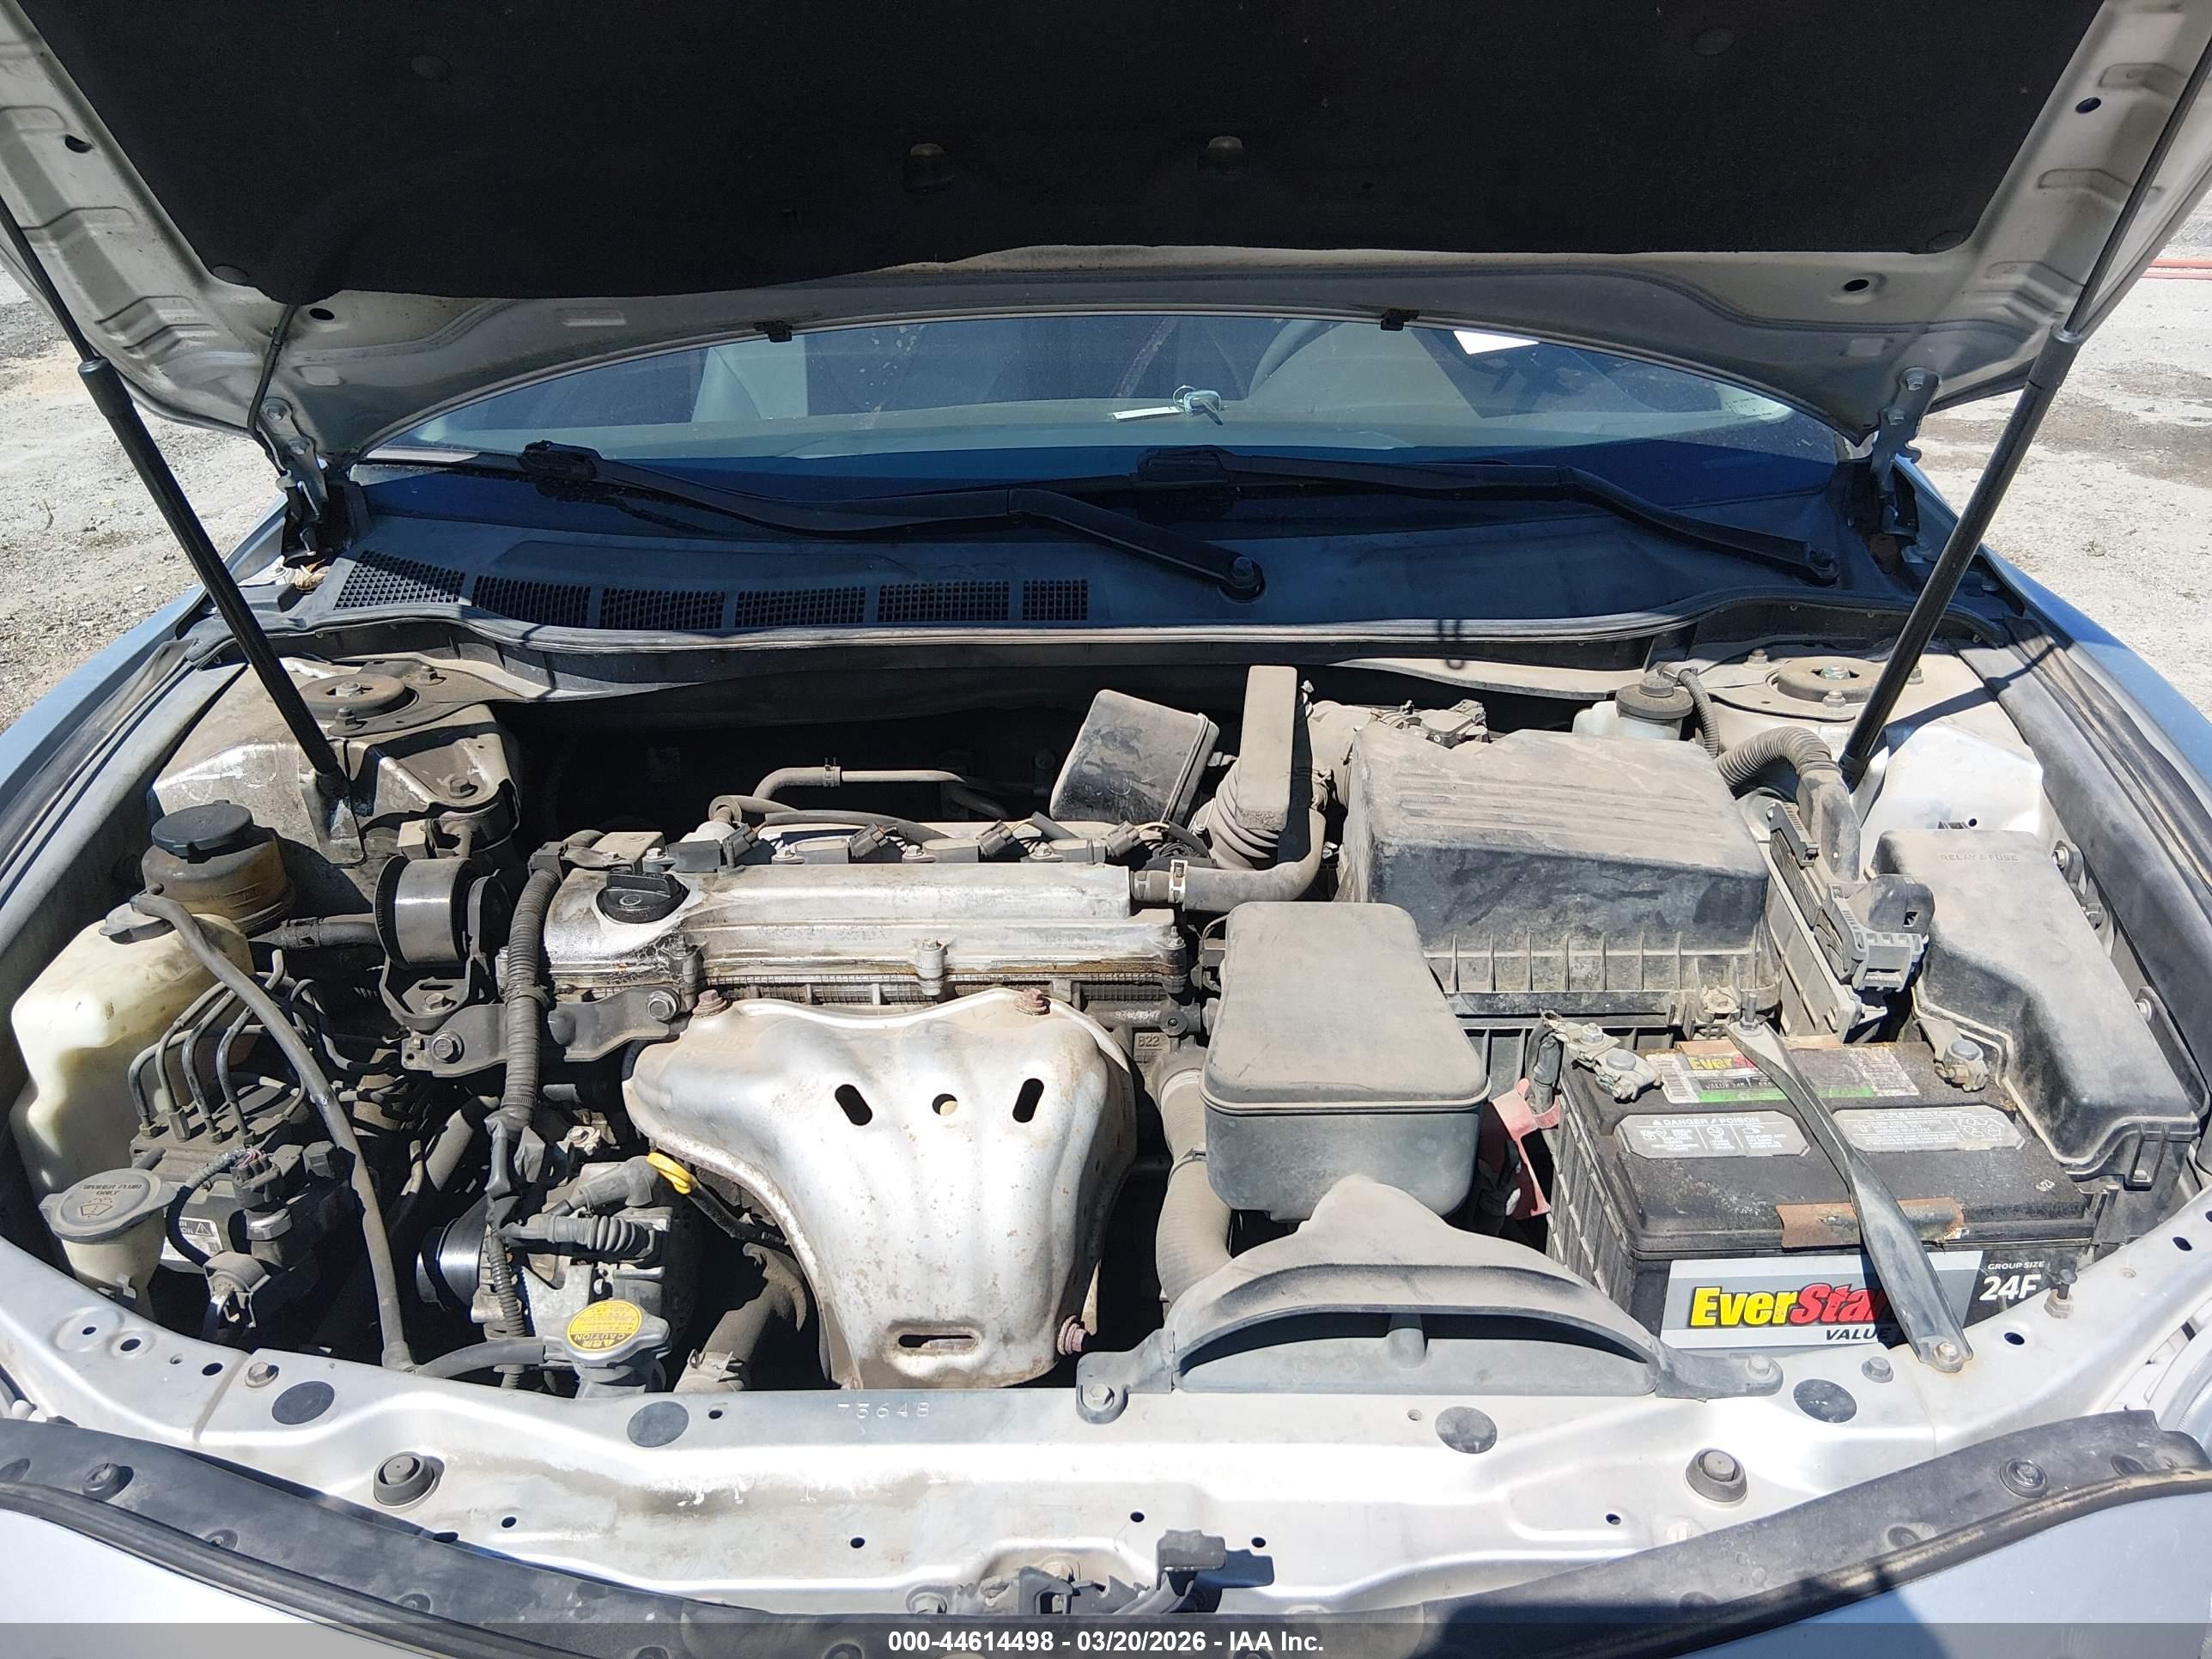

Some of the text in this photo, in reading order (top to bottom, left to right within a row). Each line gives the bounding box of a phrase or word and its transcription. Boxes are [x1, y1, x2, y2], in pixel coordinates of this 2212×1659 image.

[1988, 853, 2020, 861] FUSE
[1138, 1036, 1160, 1047] B22
[1662, 1117, 1708, 1126] DANGER
[1718, 1116, 1760, 1125] POISON
[1987, 1260, 2045, 1271] GROUP SIZE
[1978, 1273, 2043, 1302] 24F
[1826, 1327, 1891, 1341] VALUE
